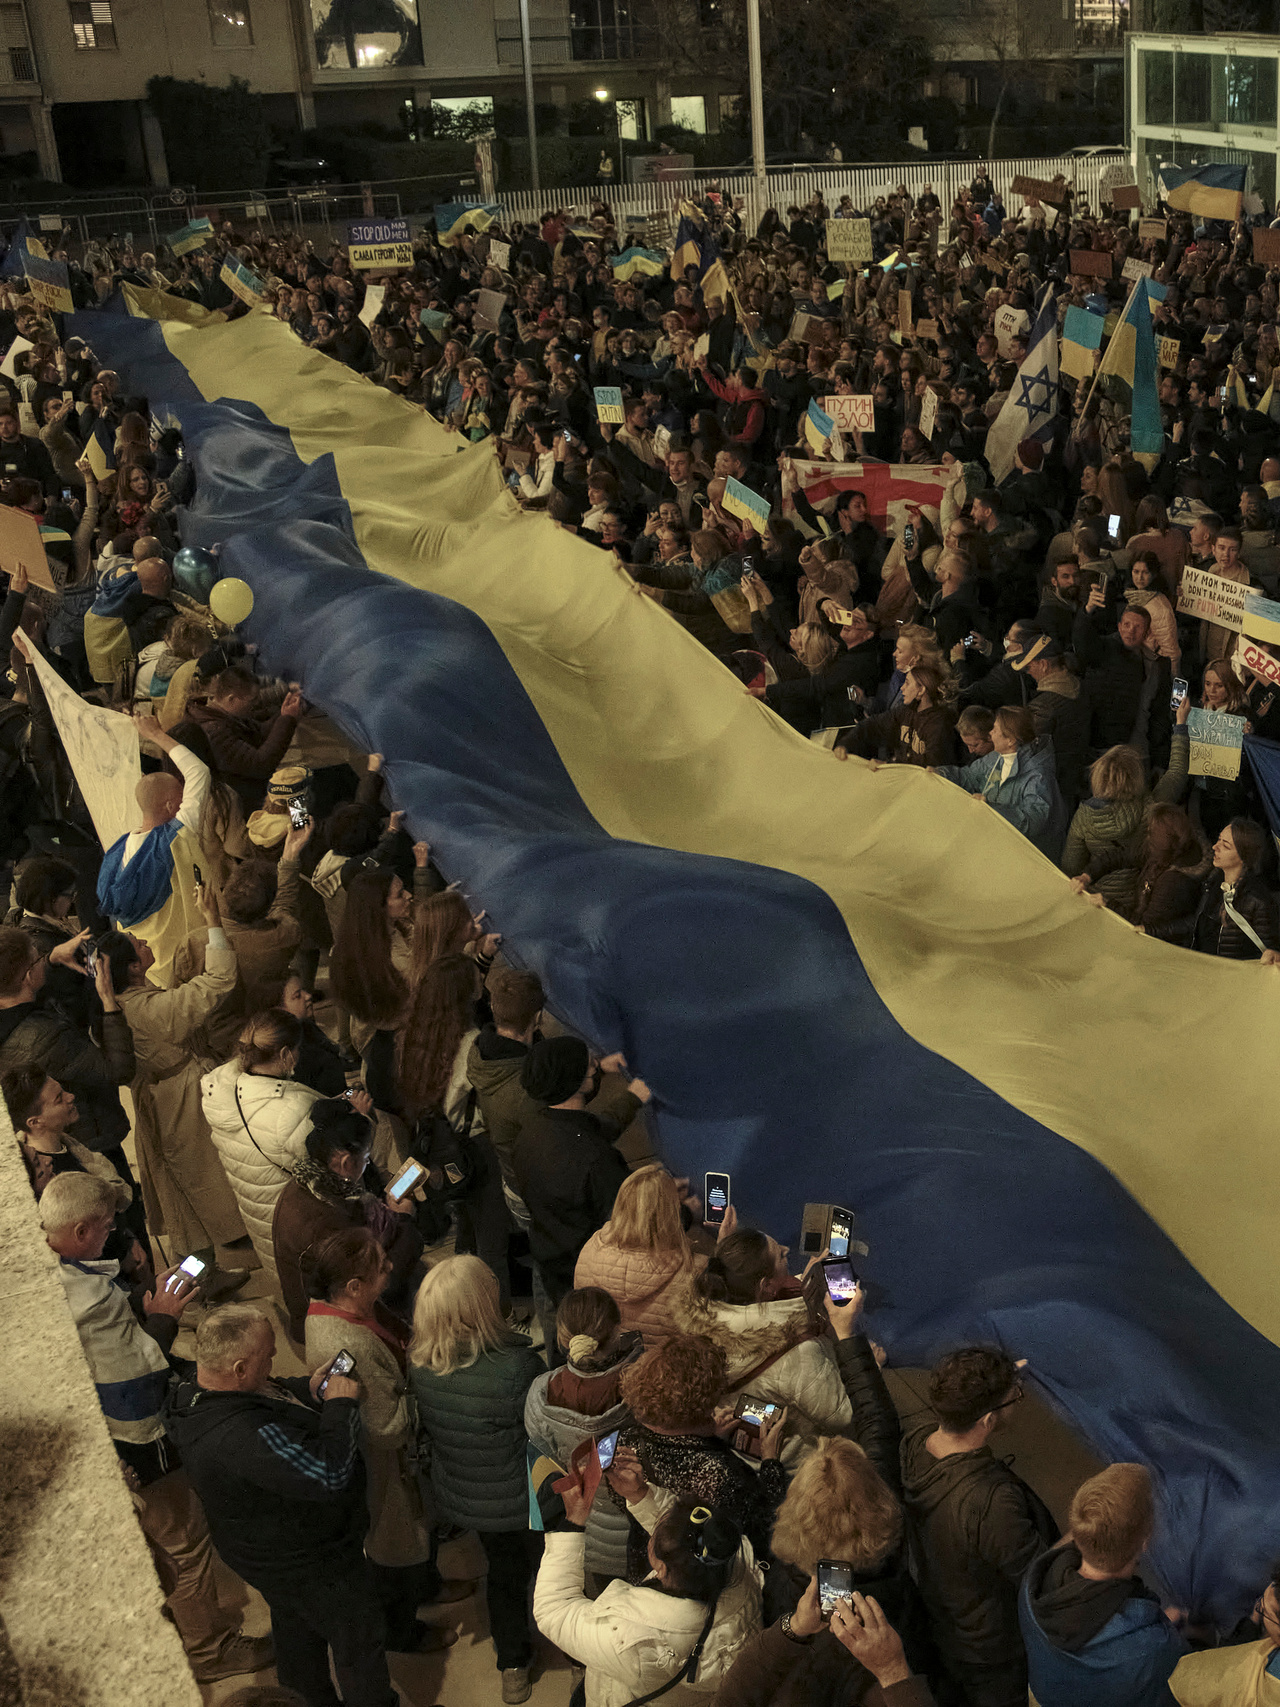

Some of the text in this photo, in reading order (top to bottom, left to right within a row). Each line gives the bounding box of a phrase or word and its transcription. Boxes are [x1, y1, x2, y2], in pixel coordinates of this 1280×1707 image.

[352, 225, 391, 242] STOP OLD
[391, 221, 406, 230] MAD
[391, 230, 408, 240] MEN
[353, 250, 374, 261] СЛАВА
[600, 405, 622, 422] PUTIN
[827, 398, 873, 413] ПУТИН
[838, 412, 873, 430] ЗЛО!
[724, 484, 743, 508] NO
[1185, 570, 1200, 583] MY
[1201, 575, 1219, 589] MOM
[1221, 581, 1238, 595] TOLD
[1180, 596, 1195, 609] BUT
[1188, 584, 1245, 610] DON'T BE AN ASSHOL
[1207, 712, 1243, 730] СЛАВА
